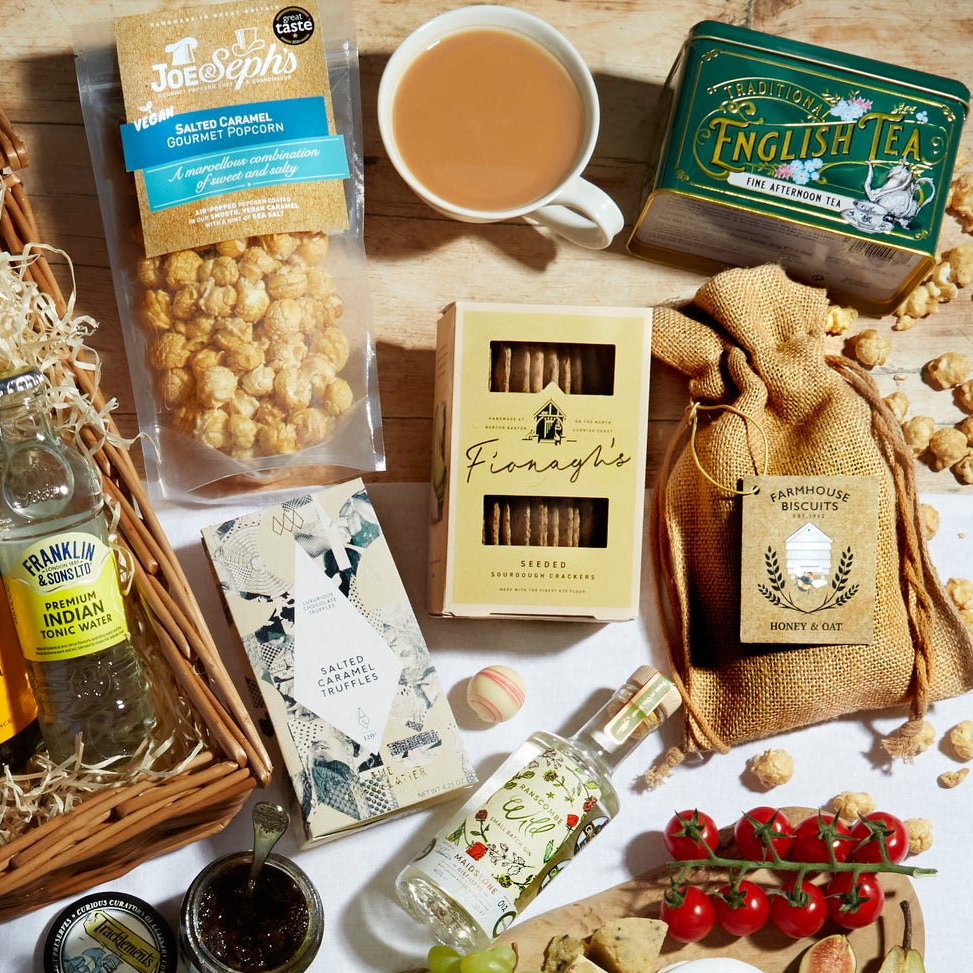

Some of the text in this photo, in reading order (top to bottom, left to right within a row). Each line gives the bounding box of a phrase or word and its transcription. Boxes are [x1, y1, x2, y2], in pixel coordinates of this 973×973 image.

[276, 19, 313, 34] taste
[283, 13, 302, 23] great
[151, 63, 199, 92] JOE
[199, 43, 297, 90] Seph's
[723, 80, 830, 123] TRADITIONAL
[133, 106, 175, 132] VEGAN
[175, 112, 273, 135] SALTED CARAMEL
[167, 123, 284, 149] GOURMET POPCORN
[708, 112, 921, 174] ENGLISH TEA
[169, 147, 320, 183] A marvellous combination
[195, 164, 299, 194] of sweet and salty
[746, 177, 841, 208] FINE AFTERNOON TEA
[466, 437, 632, 484] Fionagh's
[770, 485, 851, 503] FARMHOUSE
[781, 501, 839, 511] BISCUITS
[22, 541, 96, 577] FRANKLIN
[520, 560, 566, 568] SEEDED
[38, 562, 91, 587] & SONS LTD
[45, 590, 97, 611] PREMIUM
[40, 614, 113, 639] TONIC WATER
[43, 600, 105, 628] INDIAN
[770, 622, 843, 631] HONEY & OAT
[317, 664, 375, 688] CARAMEL
[320, 654, 365, 676] SALTED
[320, 672, 379, 698] TRUFFLES
[502, 794, 557, 839] Wild
[519, 783, 564, 826] RANSCOMBE
[489, 815, 533, 857] SMALL BATCH GIN
[453, 853, 498, 895] MAIDSTONE
[94, 918, 154, 968] Tracklements
